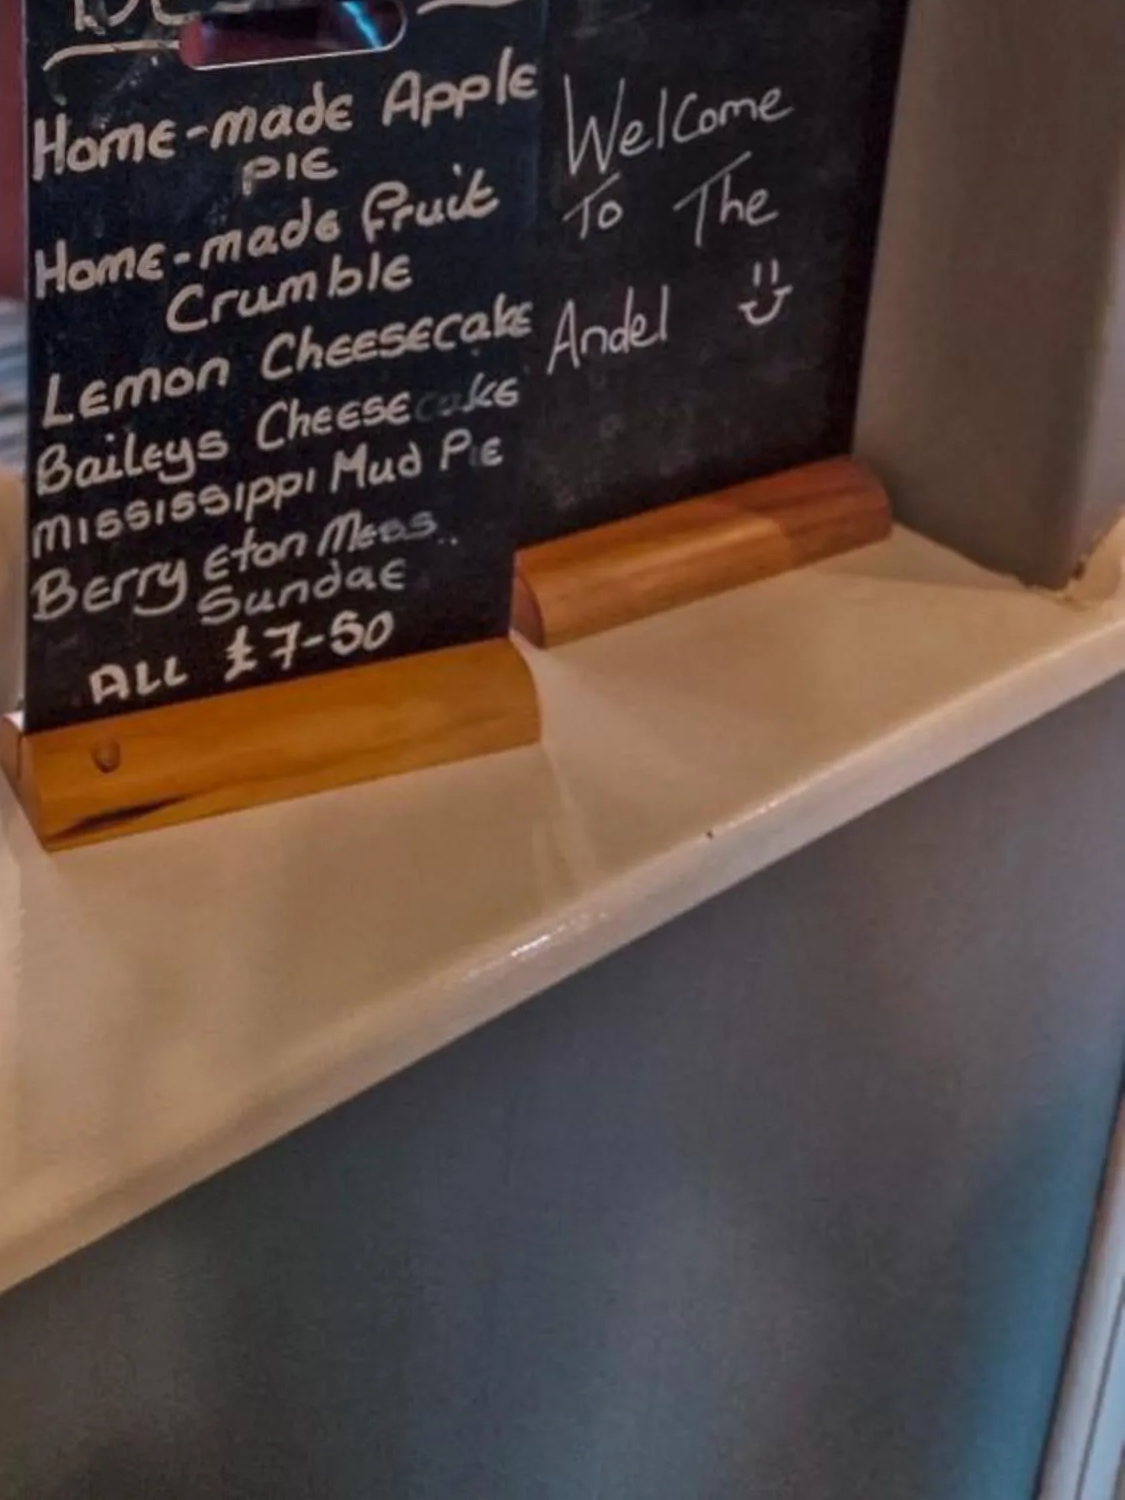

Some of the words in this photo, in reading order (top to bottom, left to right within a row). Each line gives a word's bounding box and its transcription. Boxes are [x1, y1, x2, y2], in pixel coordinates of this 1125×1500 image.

[382, 46, 539, 128] Apple
[564, 73, 794, 175] Welcome
[562, 171, 623, 240] To
[672, 151, 779, 248] The
[167, 251, 413, 332] Crumble
[546, 284, 669, 376] Andel
[42, 357, 230, 429] Lemon
[260, 293, 534, 381] Cheesecake
[35, 429, 230, 497] Baileys
[330, 441, 422, 493] Mud
[30, 560, 188, 621] Berry
[196, 558, 407, 626] Sundae
[88, 656, 188, 705] ALL
